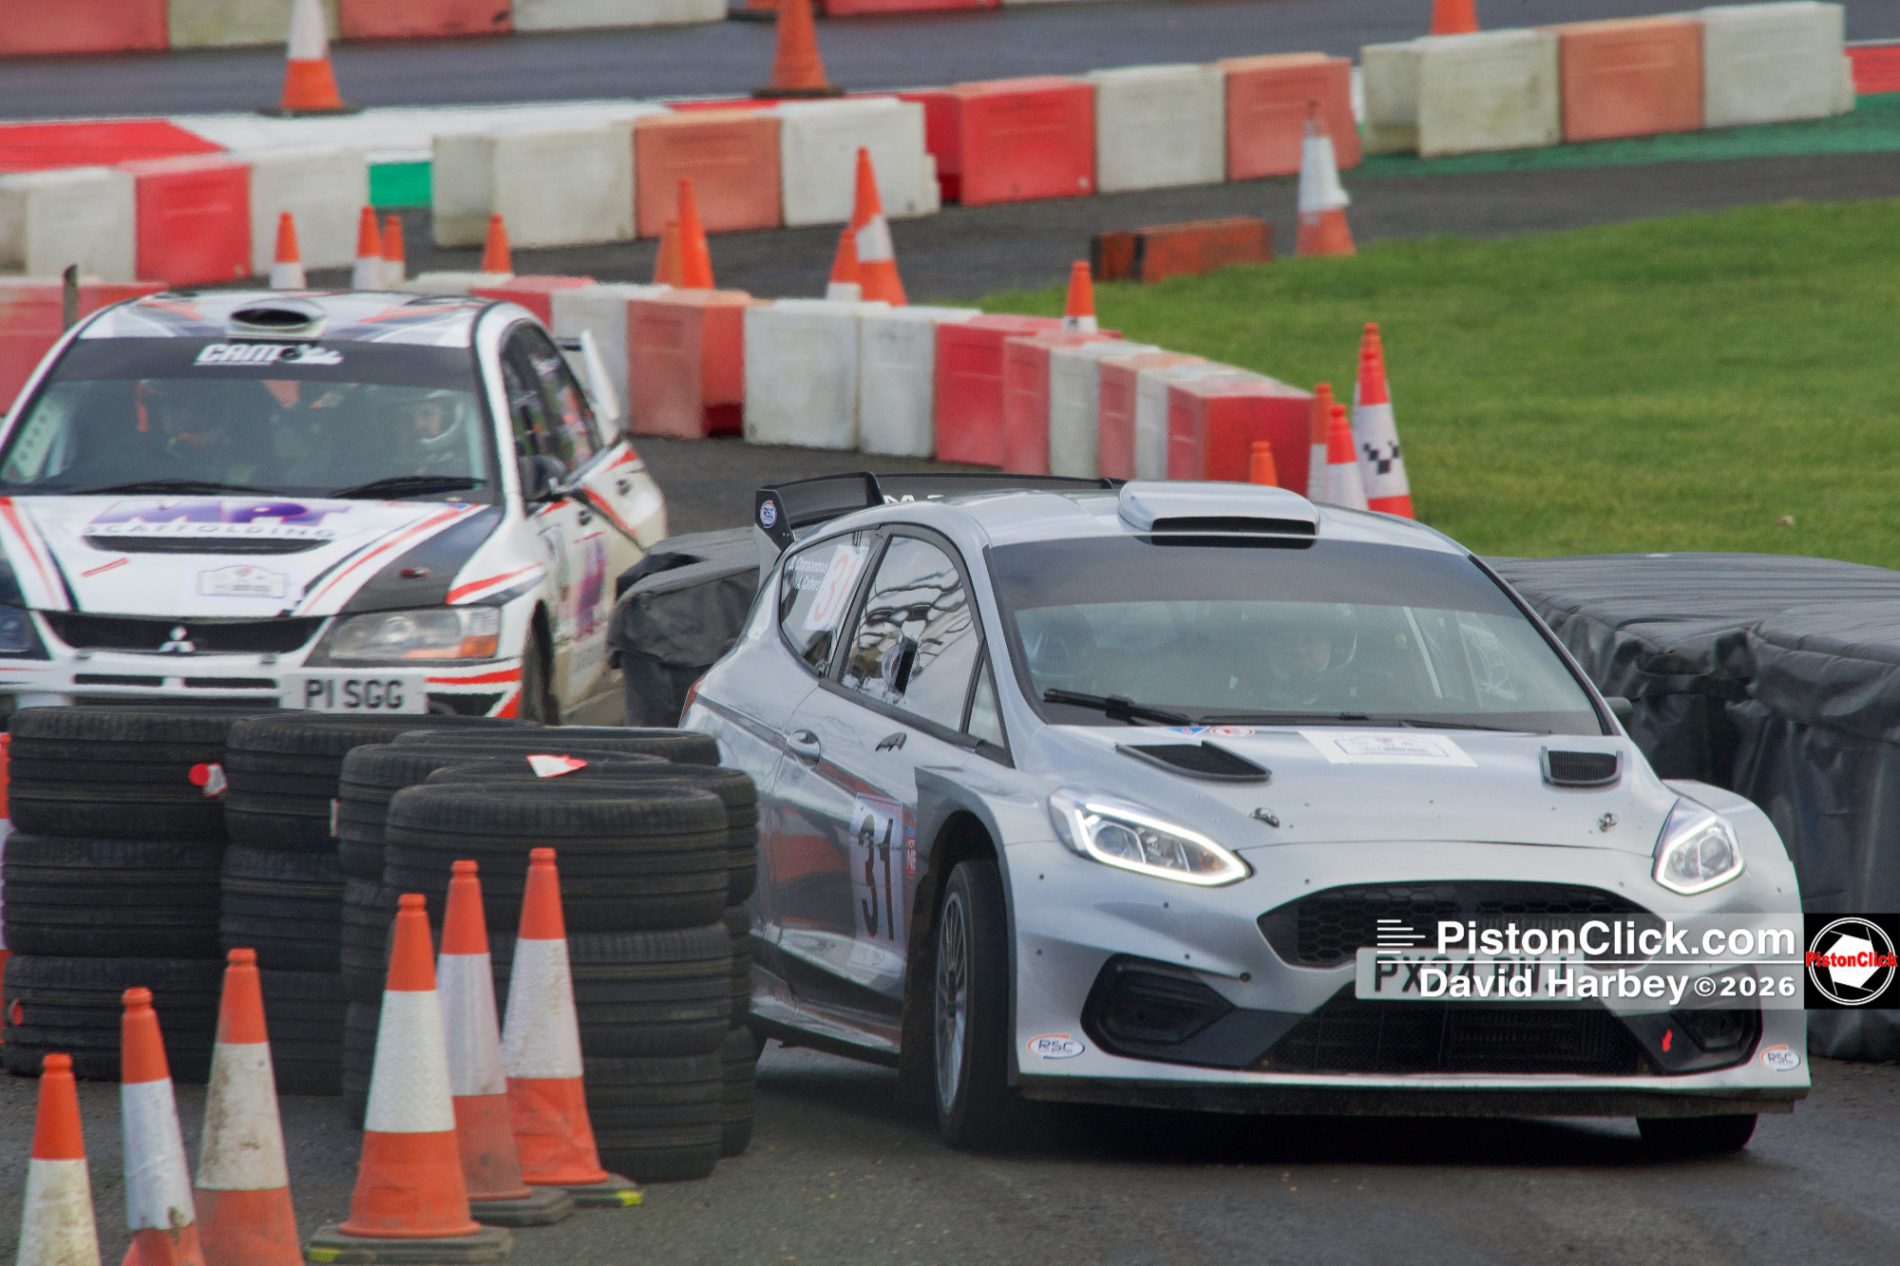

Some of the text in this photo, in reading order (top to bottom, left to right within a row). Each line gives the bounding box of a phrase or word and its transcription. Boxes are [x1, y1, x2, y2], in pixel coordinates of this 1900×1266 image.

[84, 523, 336, 539] SCAFFOLDING
[342, 679, 404, 709] SGG
[858, 813, 895, 942] 31
[1038, 1039, 1074, 1053] RSC
